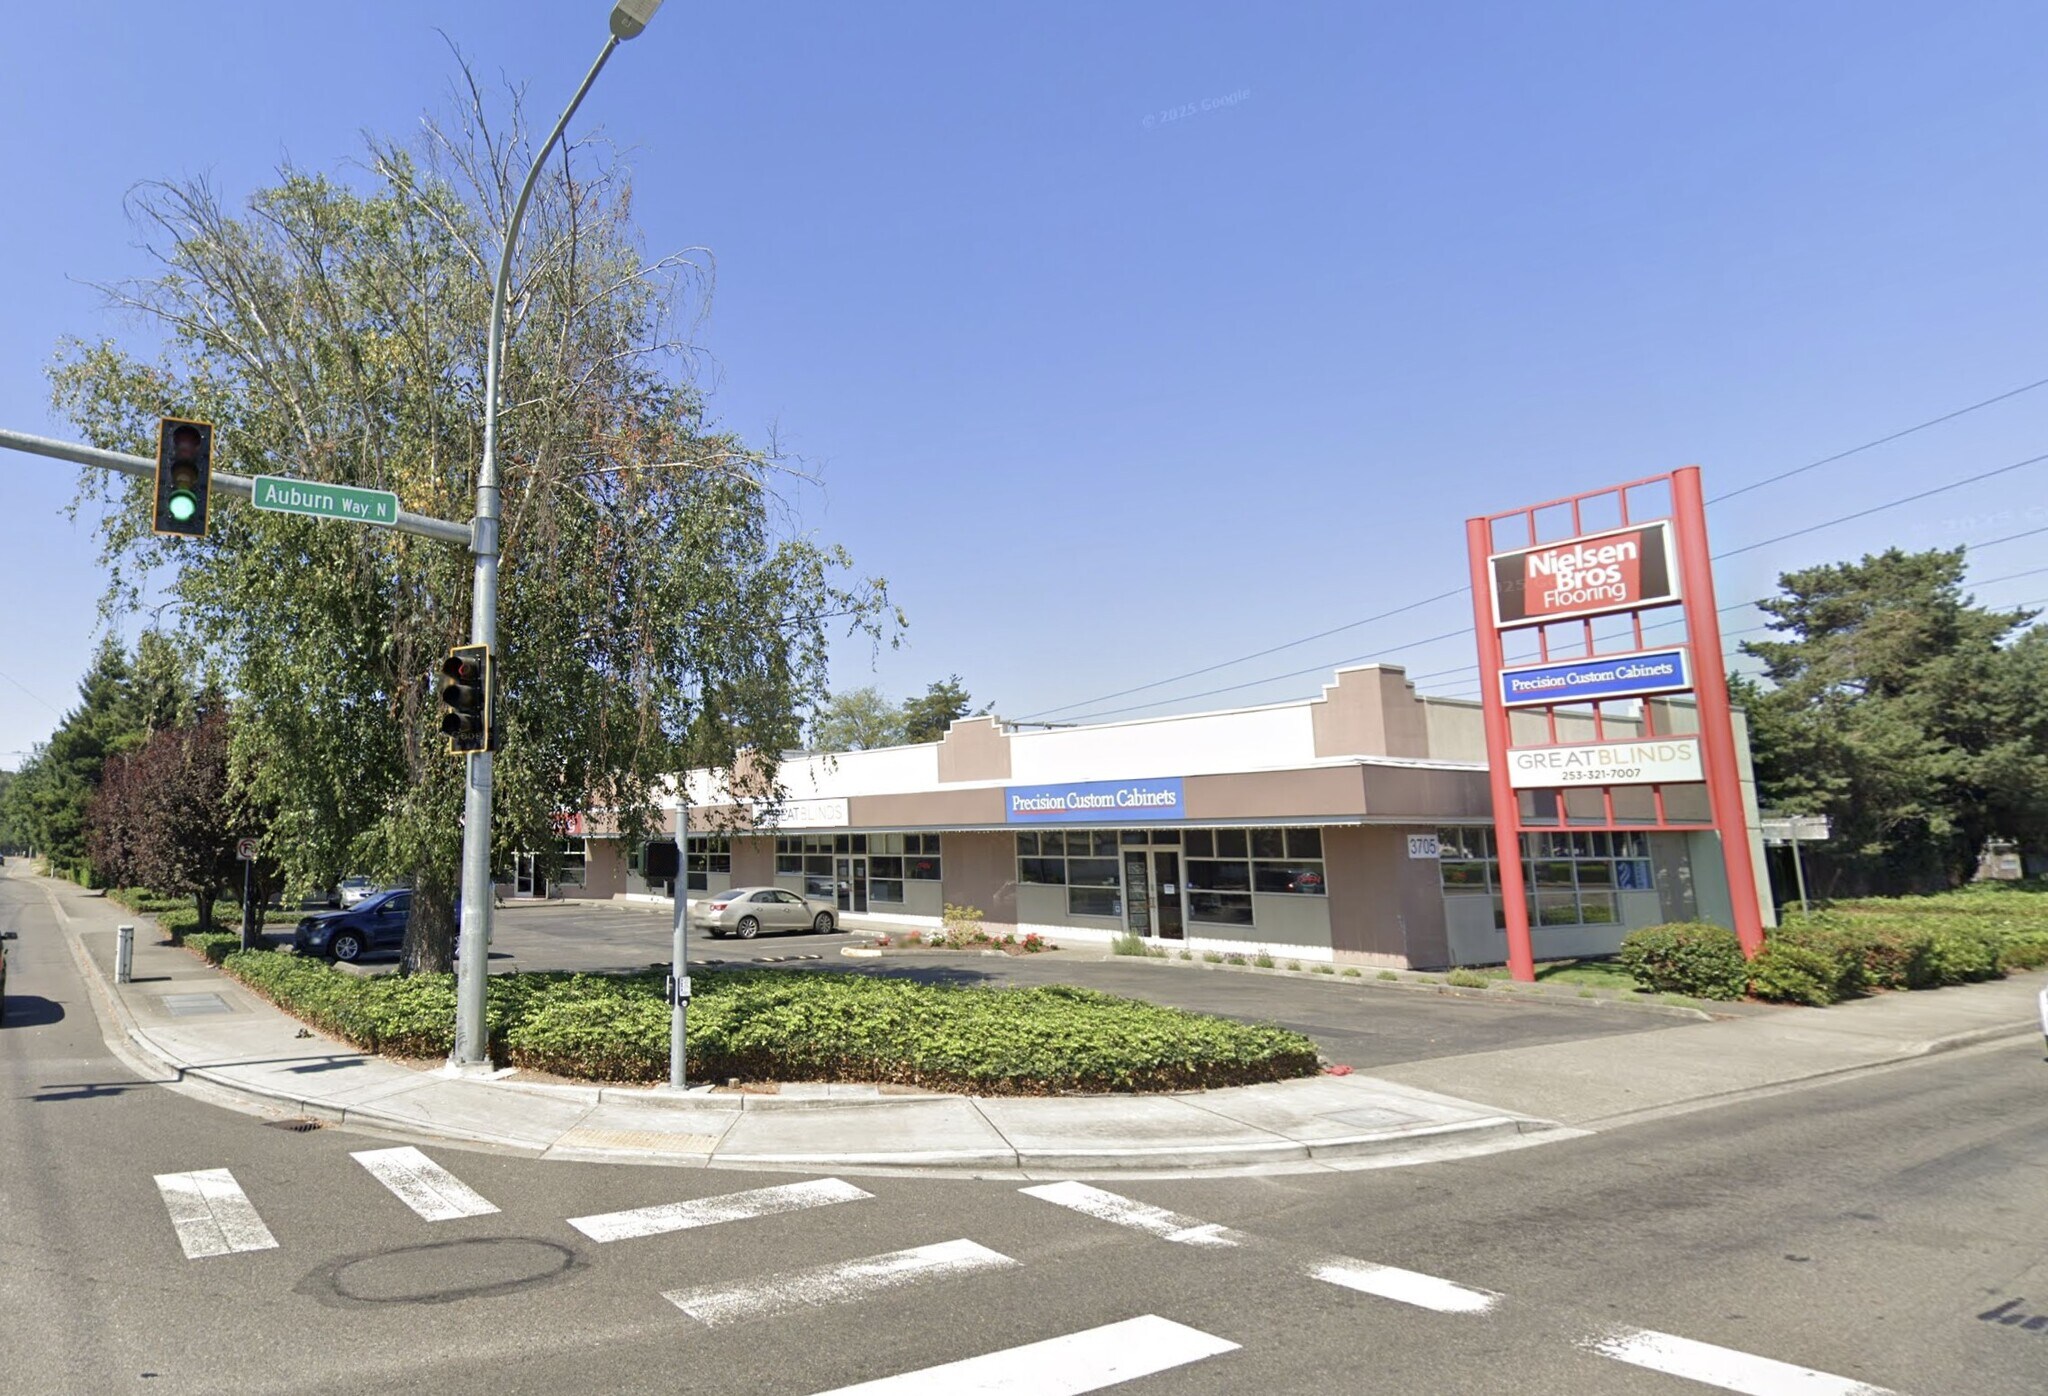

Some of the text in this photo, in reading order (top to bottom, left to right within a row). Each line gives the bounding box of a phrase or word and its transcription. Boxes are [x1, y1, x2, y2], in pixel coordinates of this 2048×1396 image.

[265, 484, 386, 518] Auburn Way N
[1528, 541, 1637, 578] Nielsen
[1555, 564, 1622, 592] Bros
[1543, 582, 1627, 608] Flooring
[1511, 662, 1674, 691] Precision Custom Cabinets
[1562, 768, 1641, 781] 253-321-7007
[1012, 787, 1177, 811] Precision Custom Cabinets
[765, 804, 842, 822] EATBLNDS
[1410, 838, 1436, 854] 3705
